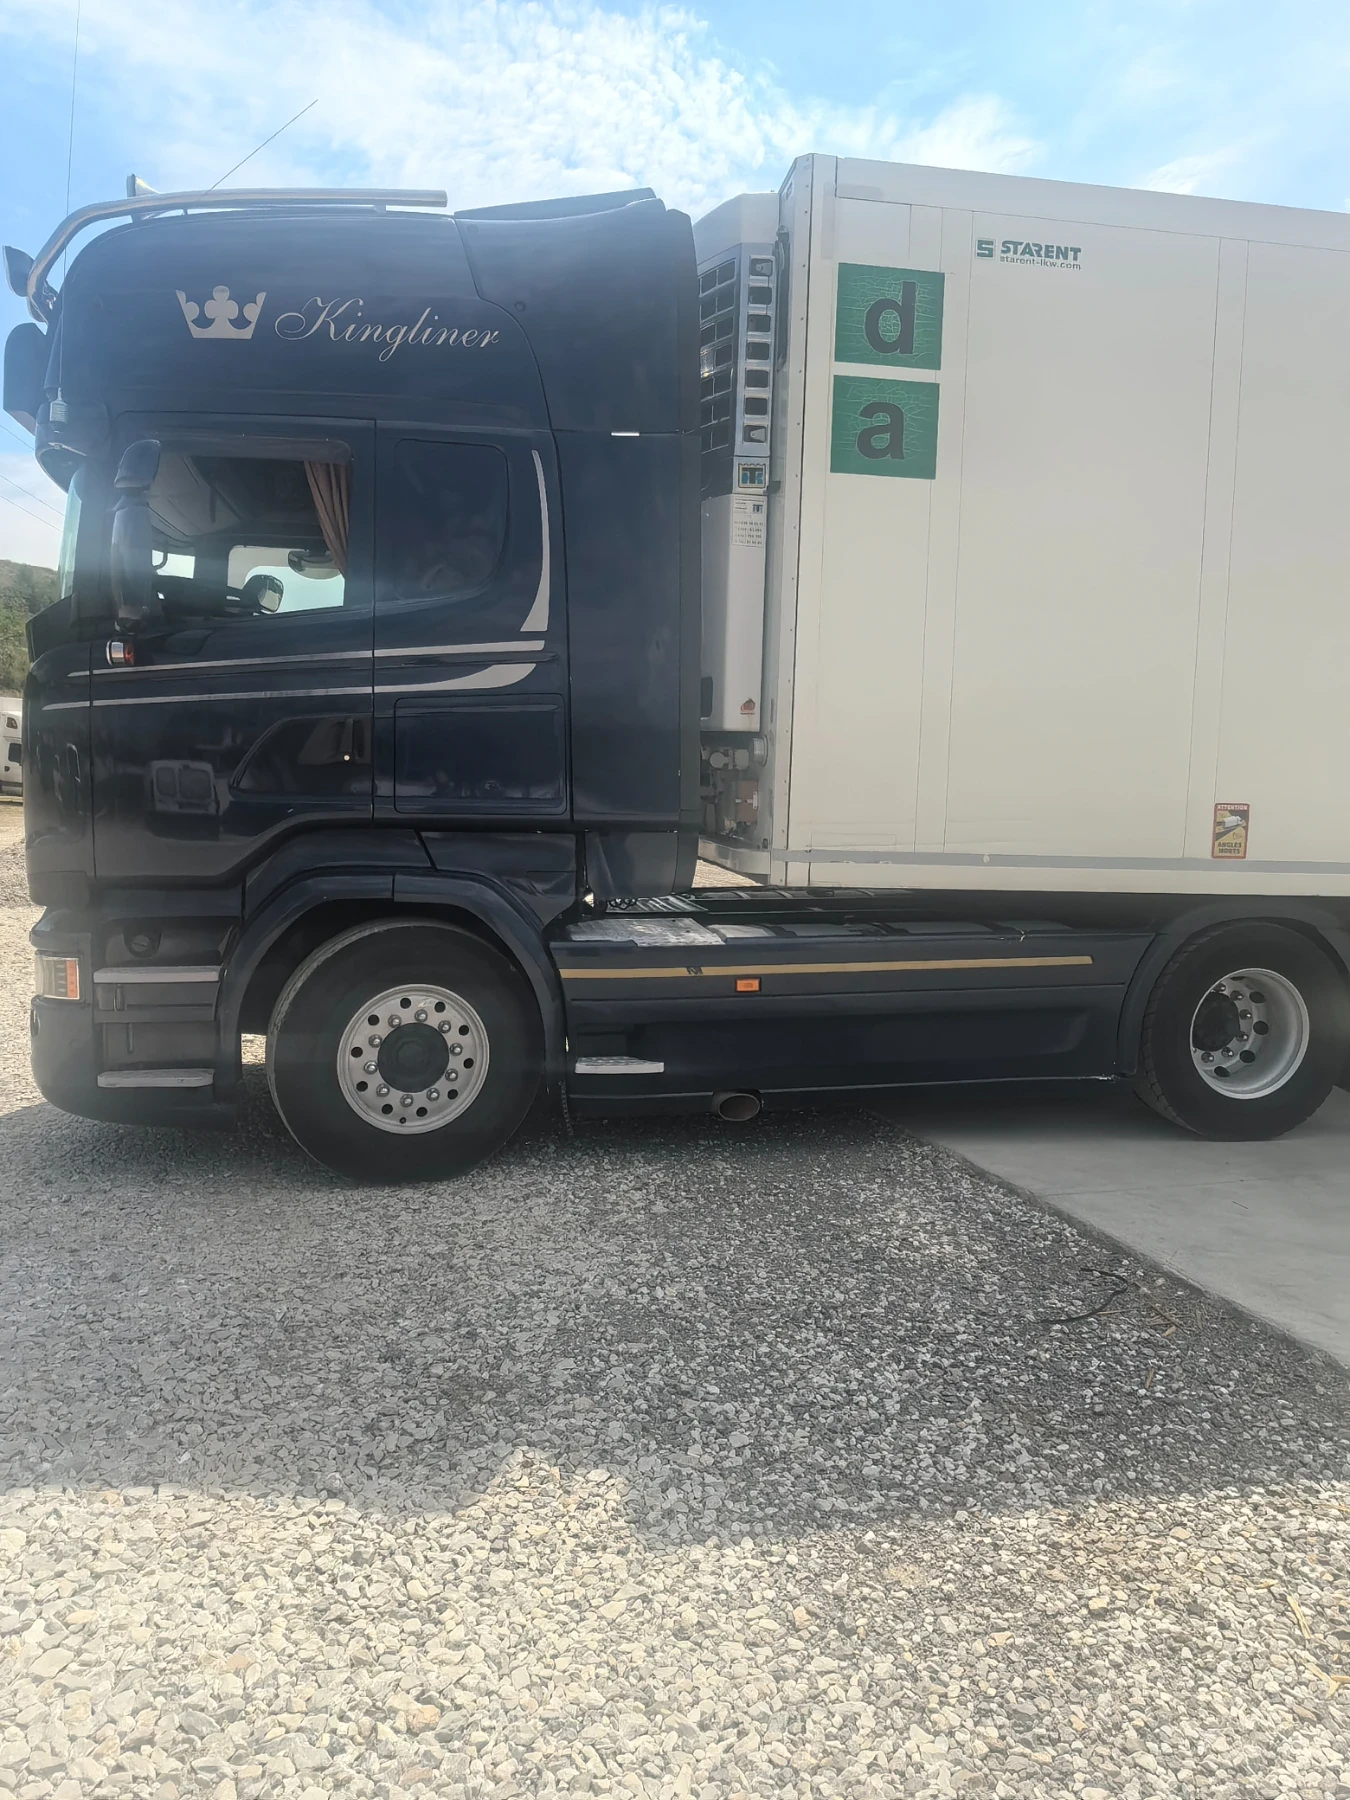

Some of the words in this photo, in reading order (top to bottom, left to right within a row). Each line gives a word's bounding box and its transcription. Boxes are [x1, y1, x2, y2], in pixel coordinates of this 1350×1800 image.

[1000, 240, 1082, 262] STARENT
[1000, 255, 1082, 271] starent-lkw.com
[274, 296, 499, 362] Kingliner
[864, 280, 917, 354] d
[856, 401, 905, 460] a
